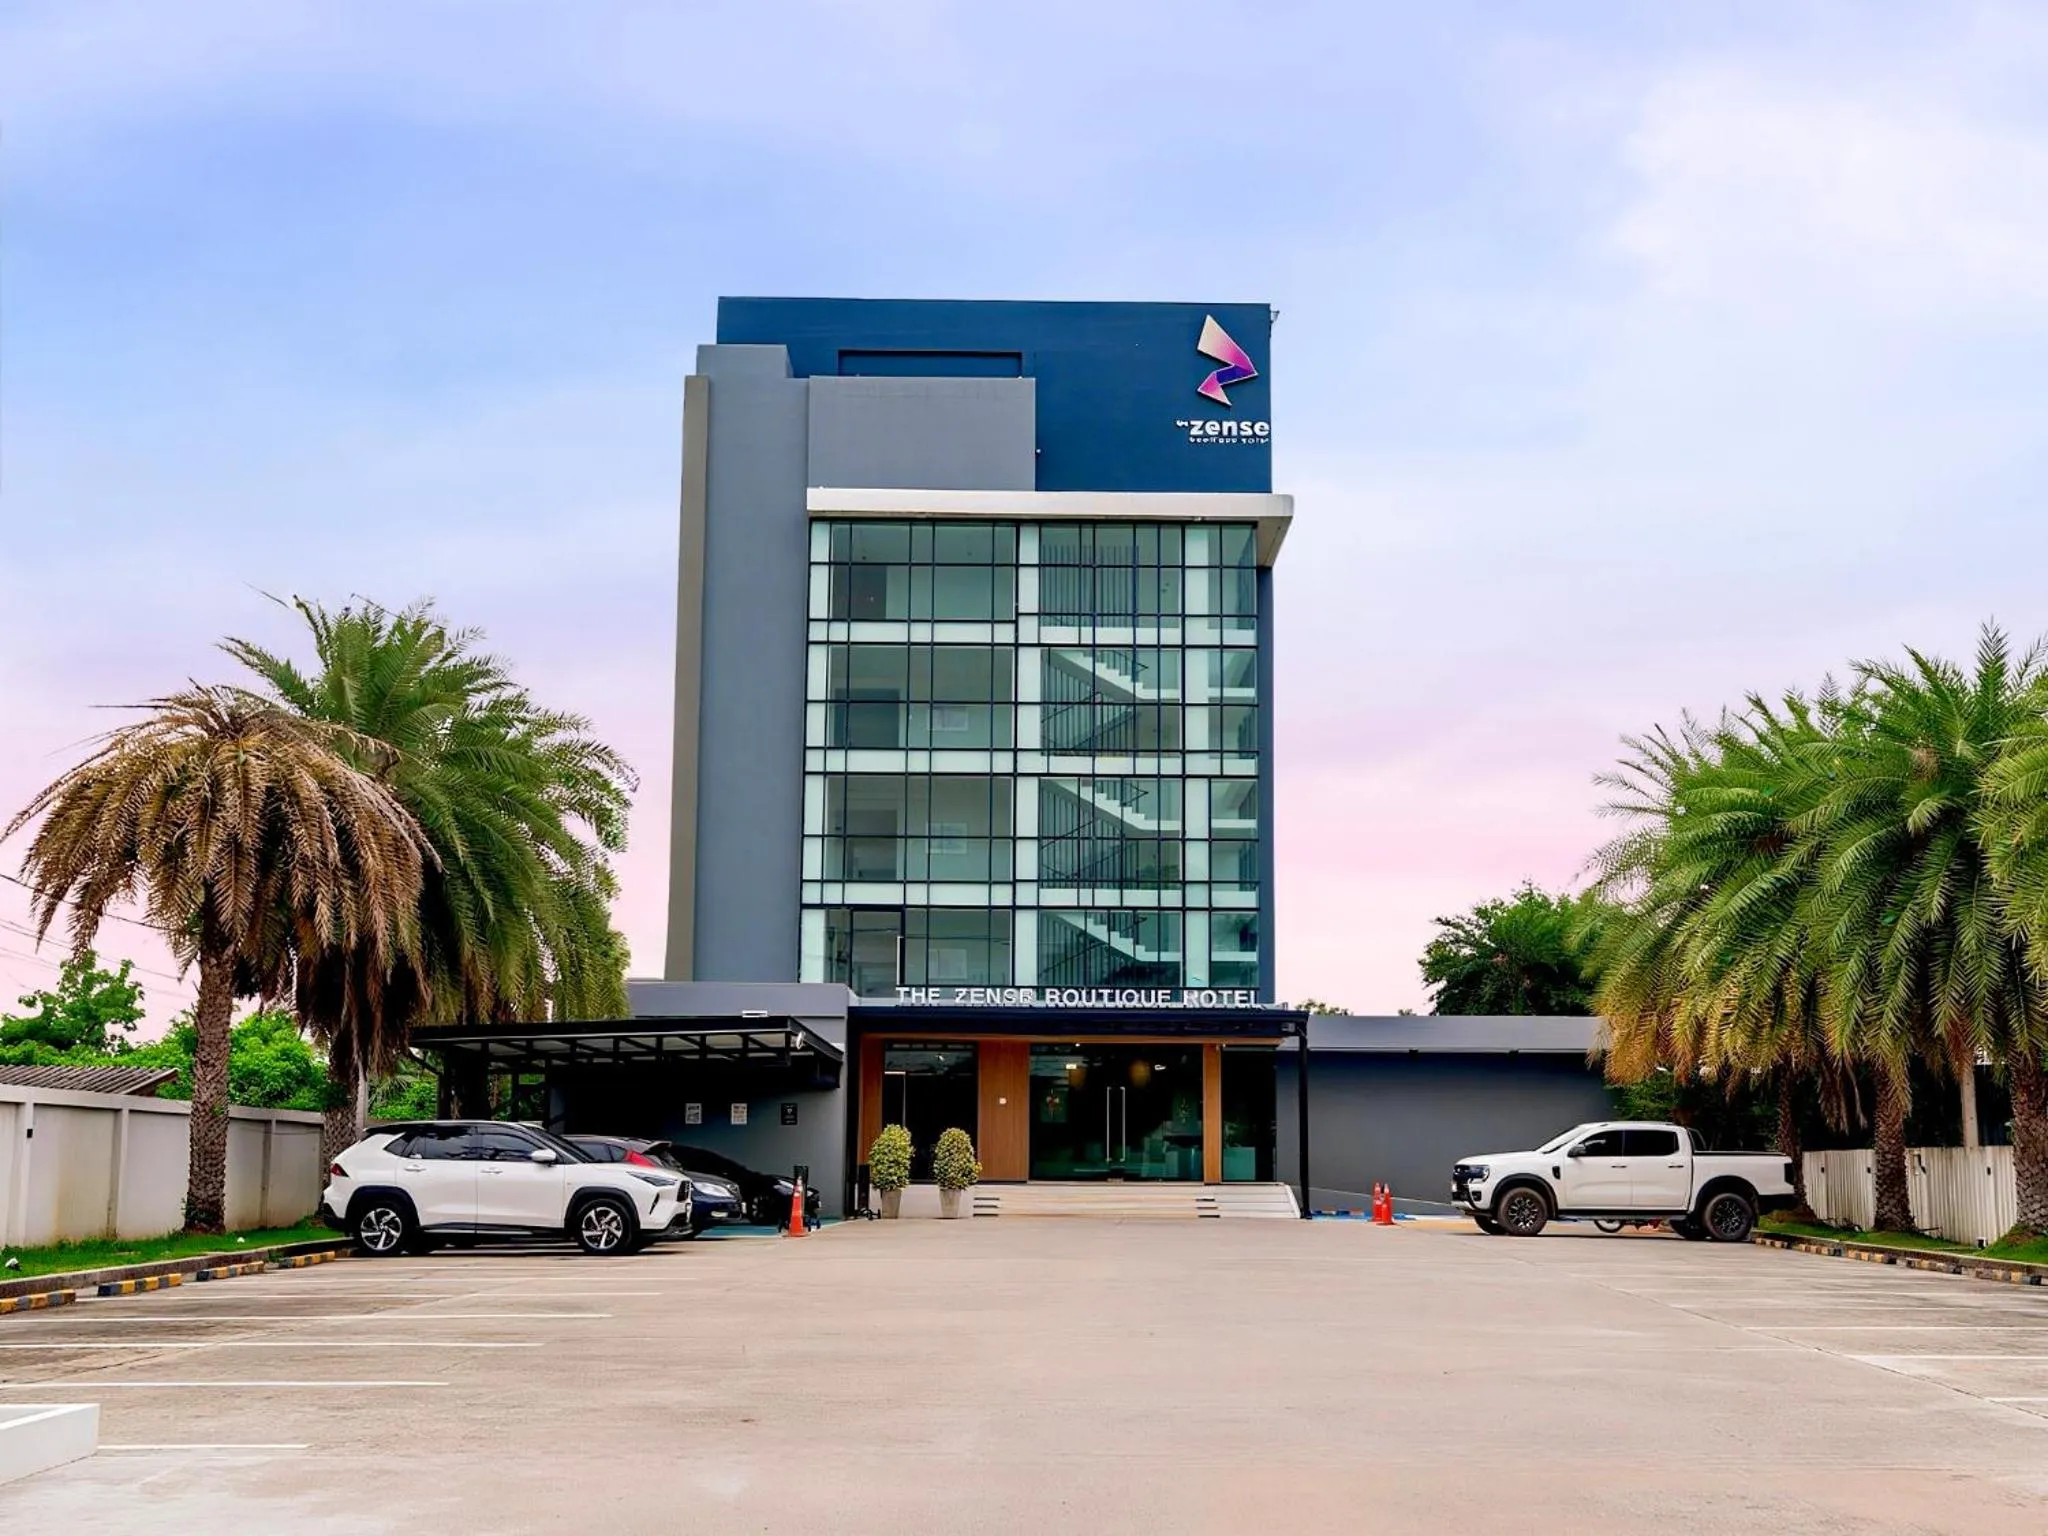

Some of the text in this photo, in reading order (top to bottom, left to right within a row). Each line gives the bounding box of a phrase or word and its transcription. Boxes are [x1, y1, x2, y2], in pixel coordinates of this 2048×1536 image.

[1189, 420, 1270, 436] zense
[895, 986, 941, 1005] THE
[1045, 987, 1171, 1007] BOUTIQUE
